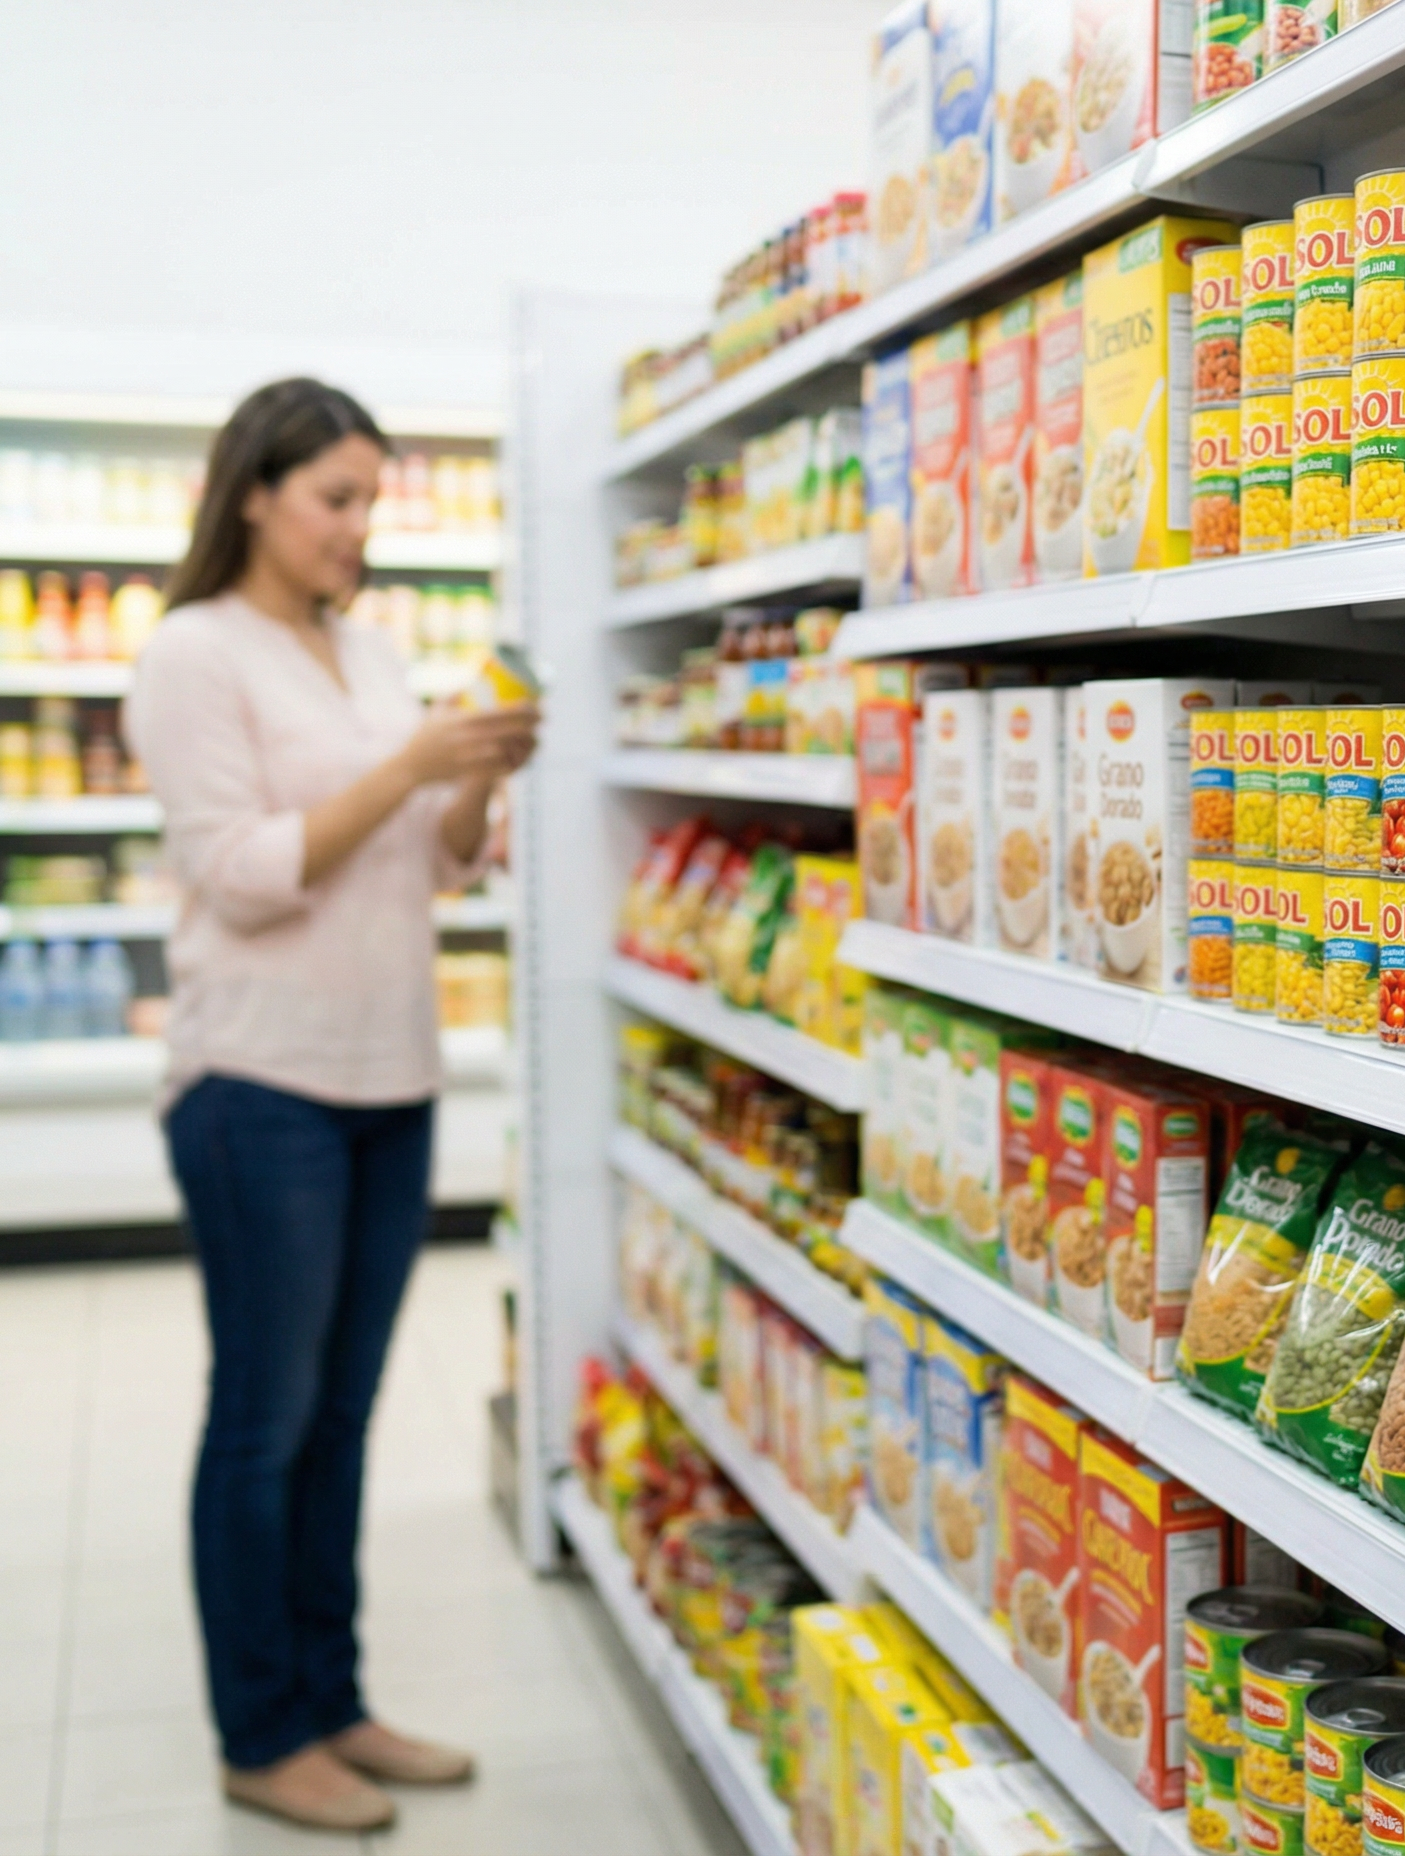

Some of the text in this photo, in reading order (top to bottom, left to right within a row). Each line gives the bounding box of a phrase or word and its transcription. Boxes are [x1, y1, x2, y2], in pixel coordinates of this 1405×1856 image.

[1190, 732, 1234, 762] OL
[1235, 733, 1278, 763] OL
[1191, 880, 1234, 910] OL
[1234, 887, 1277, 915] OL
[1351, 1198, 1405, 1243] Grano
